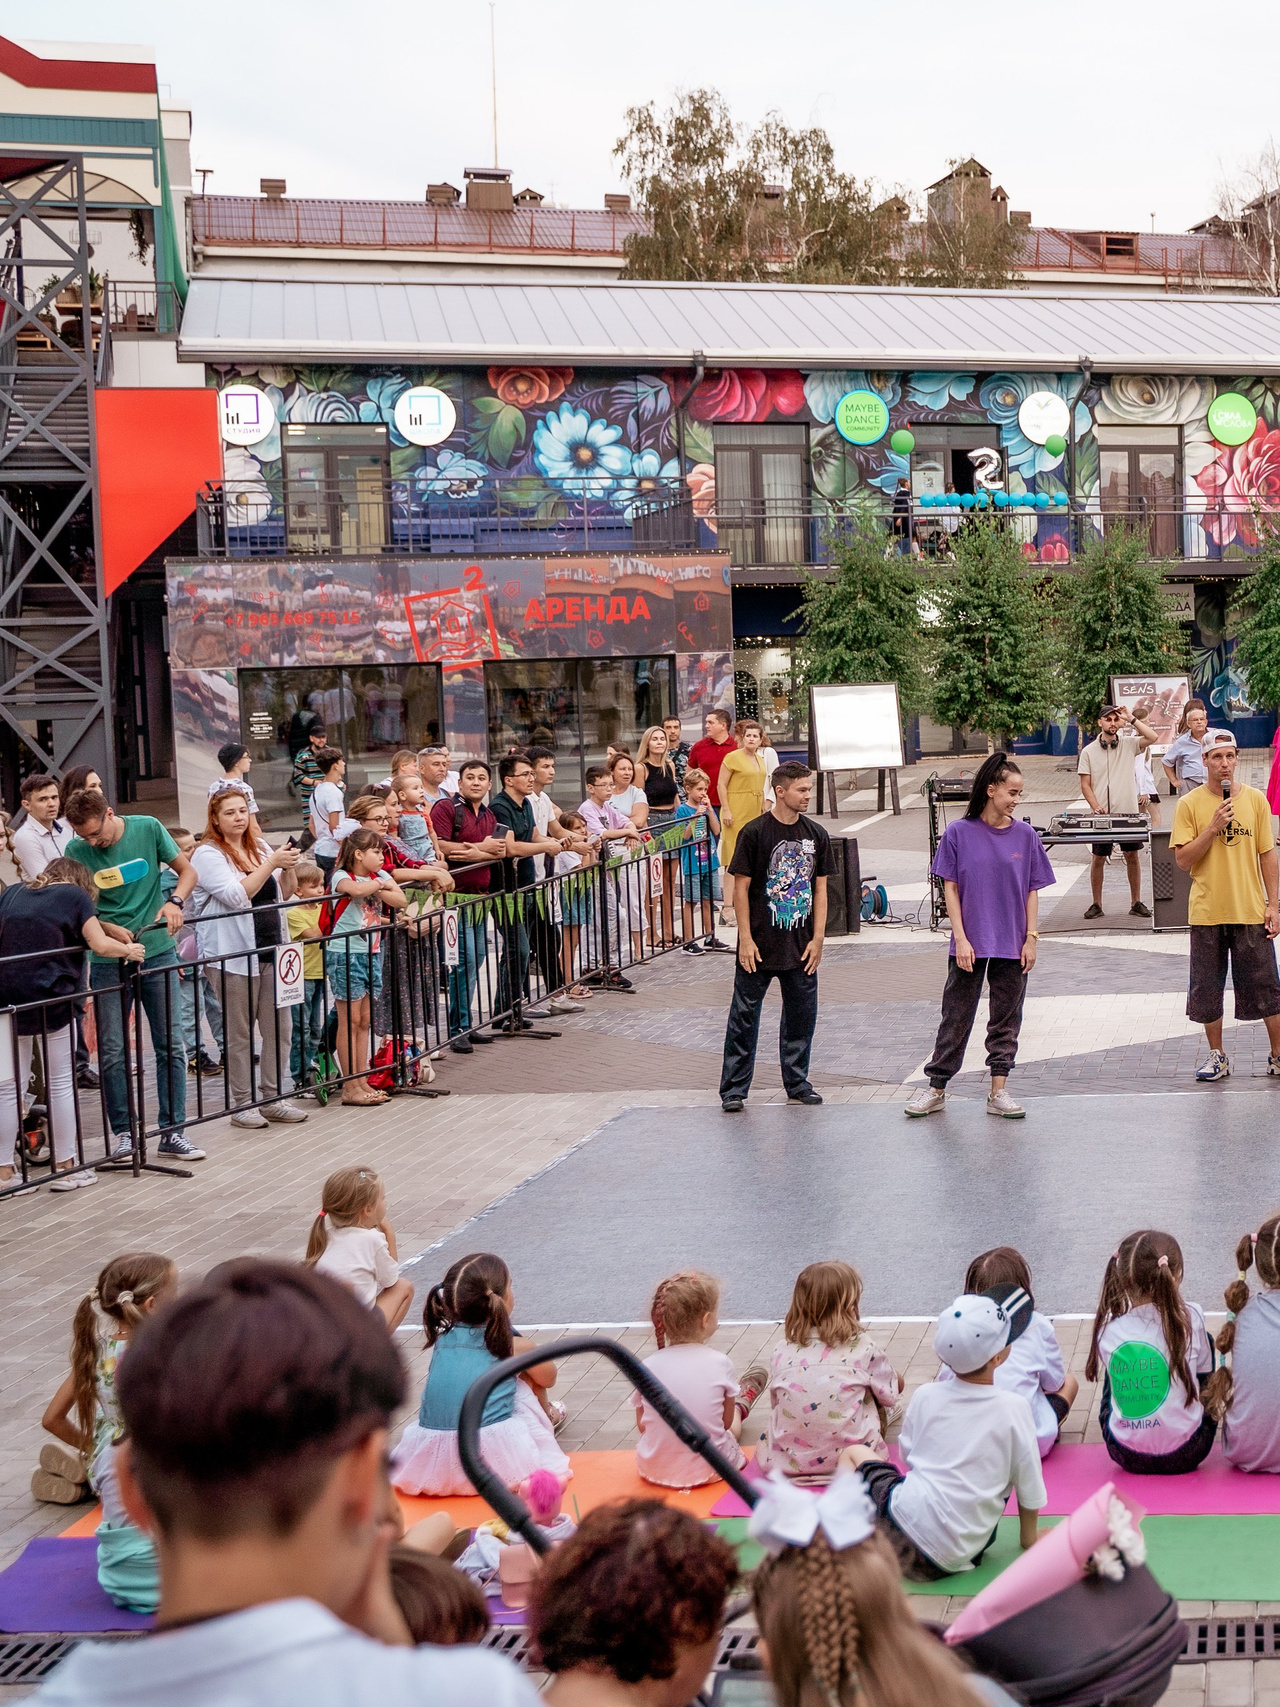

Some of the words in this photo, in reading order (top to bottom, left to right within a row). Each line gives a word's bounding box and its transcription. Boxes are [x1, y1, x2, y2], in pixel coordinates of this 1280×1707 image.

[845, 403, 881, 413] MAYBE
[845, 415, 881, 424] DANCE
[523, 596, 652, 625] АРЕНДА
[225, 612, 245, 627] +7
[248, 612, 280, 626] 965
[283, 611, 315, 626] 669
[317, 610, 338, 625] 75
[341, 610, 361, 625] 15
[1122, 683, 1155, 695] SENS
[1112, 1356, 1159, 1375] MAYBE
